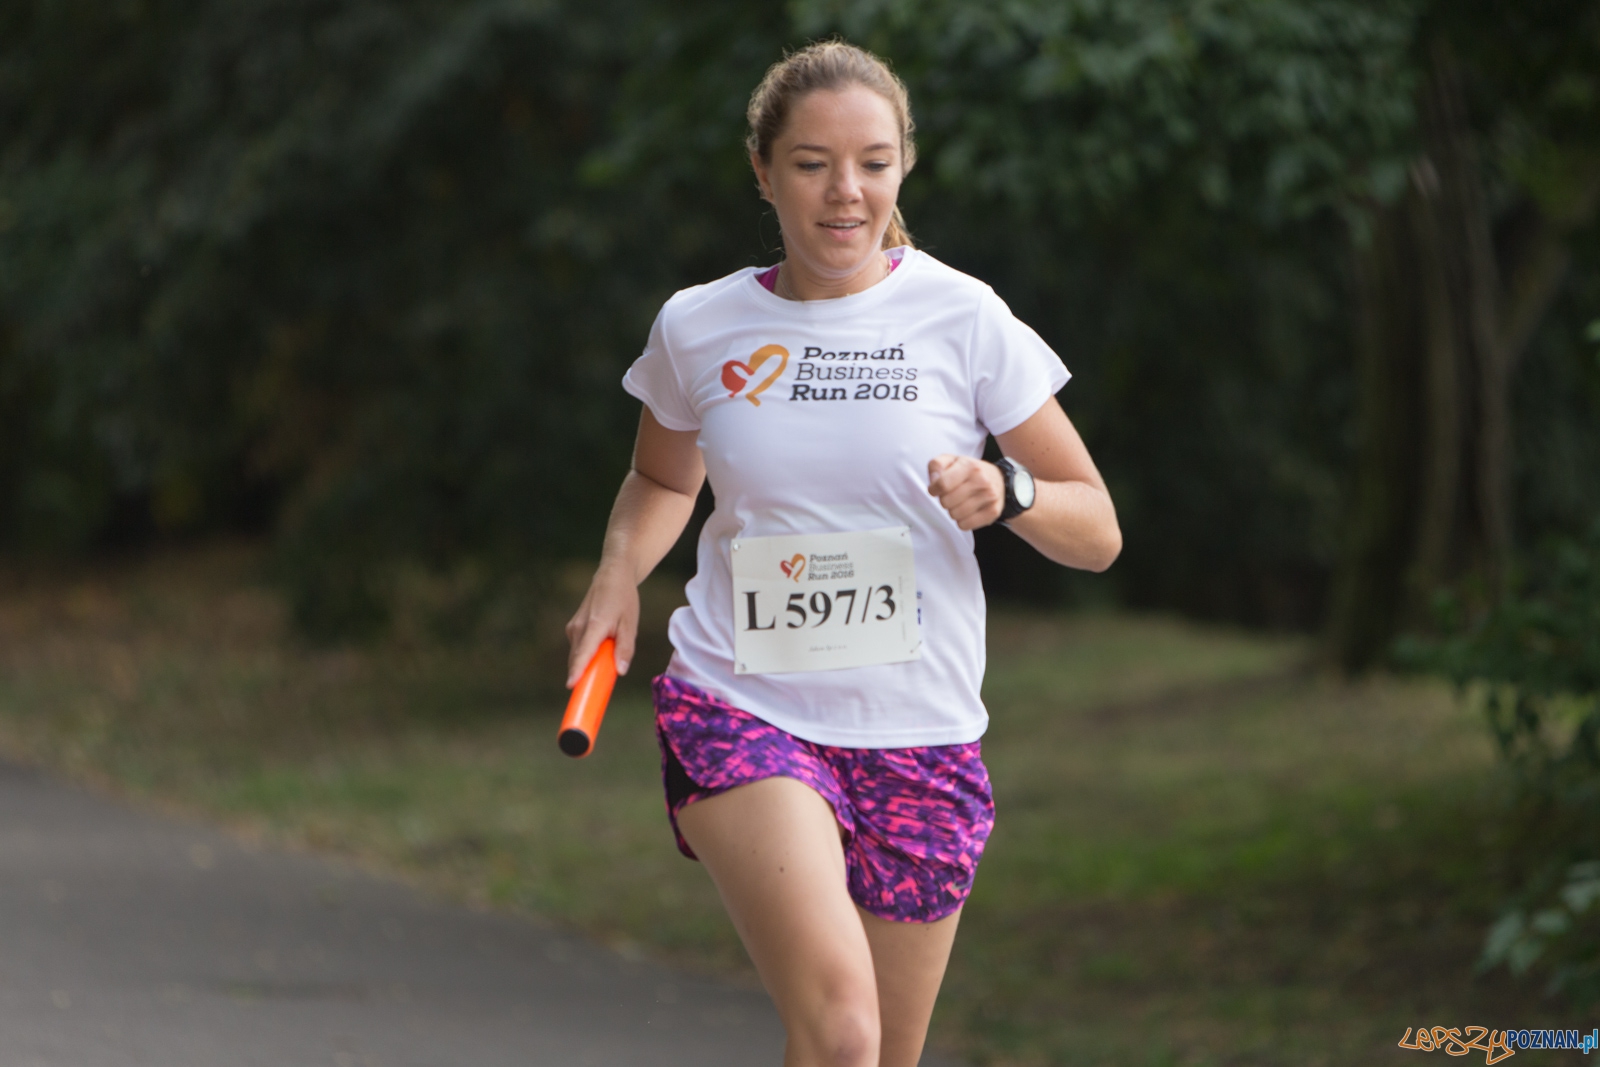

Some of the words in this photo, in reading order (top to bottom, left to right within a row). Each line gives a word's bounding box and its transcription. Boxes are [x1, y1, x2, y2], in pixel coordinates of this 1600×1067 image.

[801, 344, 905, 361] Poznań
[794, 362, 918, 381] Business
[789, 384, 847, 401] Run
[853, 383, 918, 401] 2016
[808, 572, 829, 581] Run
[743, 590, 776, 631] L
[786, 584, 896, 629] 597/3
